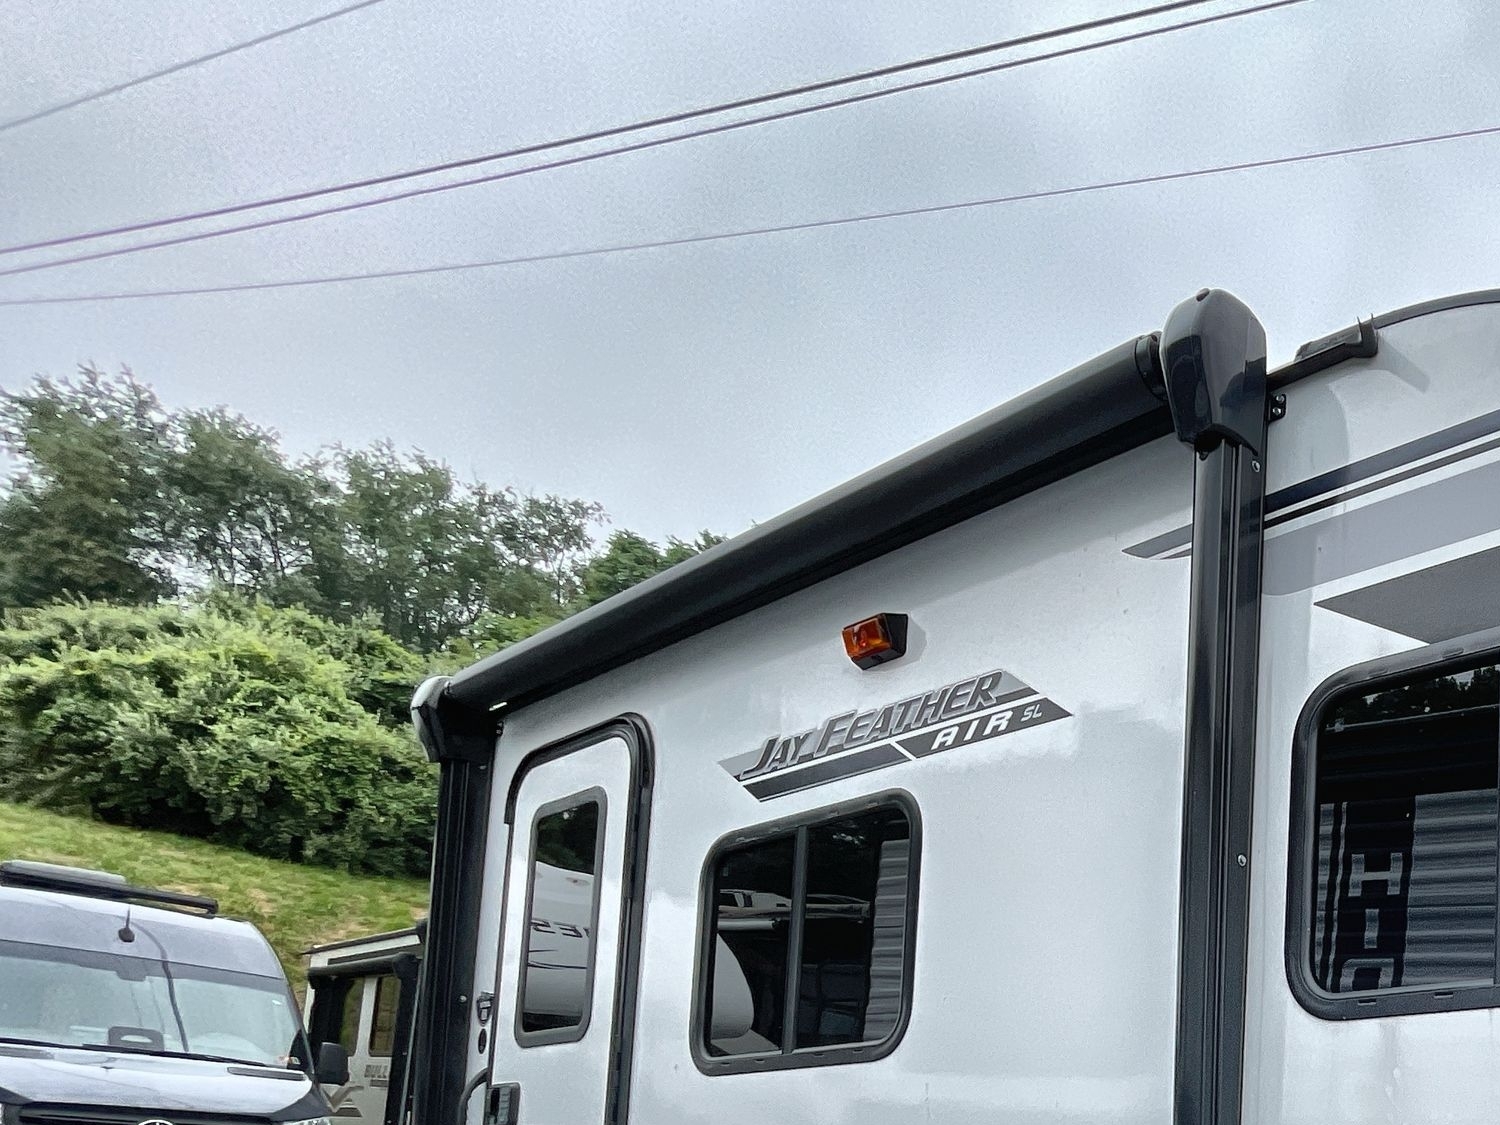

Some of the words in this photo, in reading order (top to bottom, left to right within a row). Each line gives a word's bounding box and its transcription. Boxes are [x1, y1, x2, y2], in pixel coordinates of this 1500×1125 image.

[739, 731, 817, 781] JAY
[813, 669, 1003, 759] FEATHER
[931, 710, 1012, 751] AIR
[1021, 703, 1043, 722] SL
